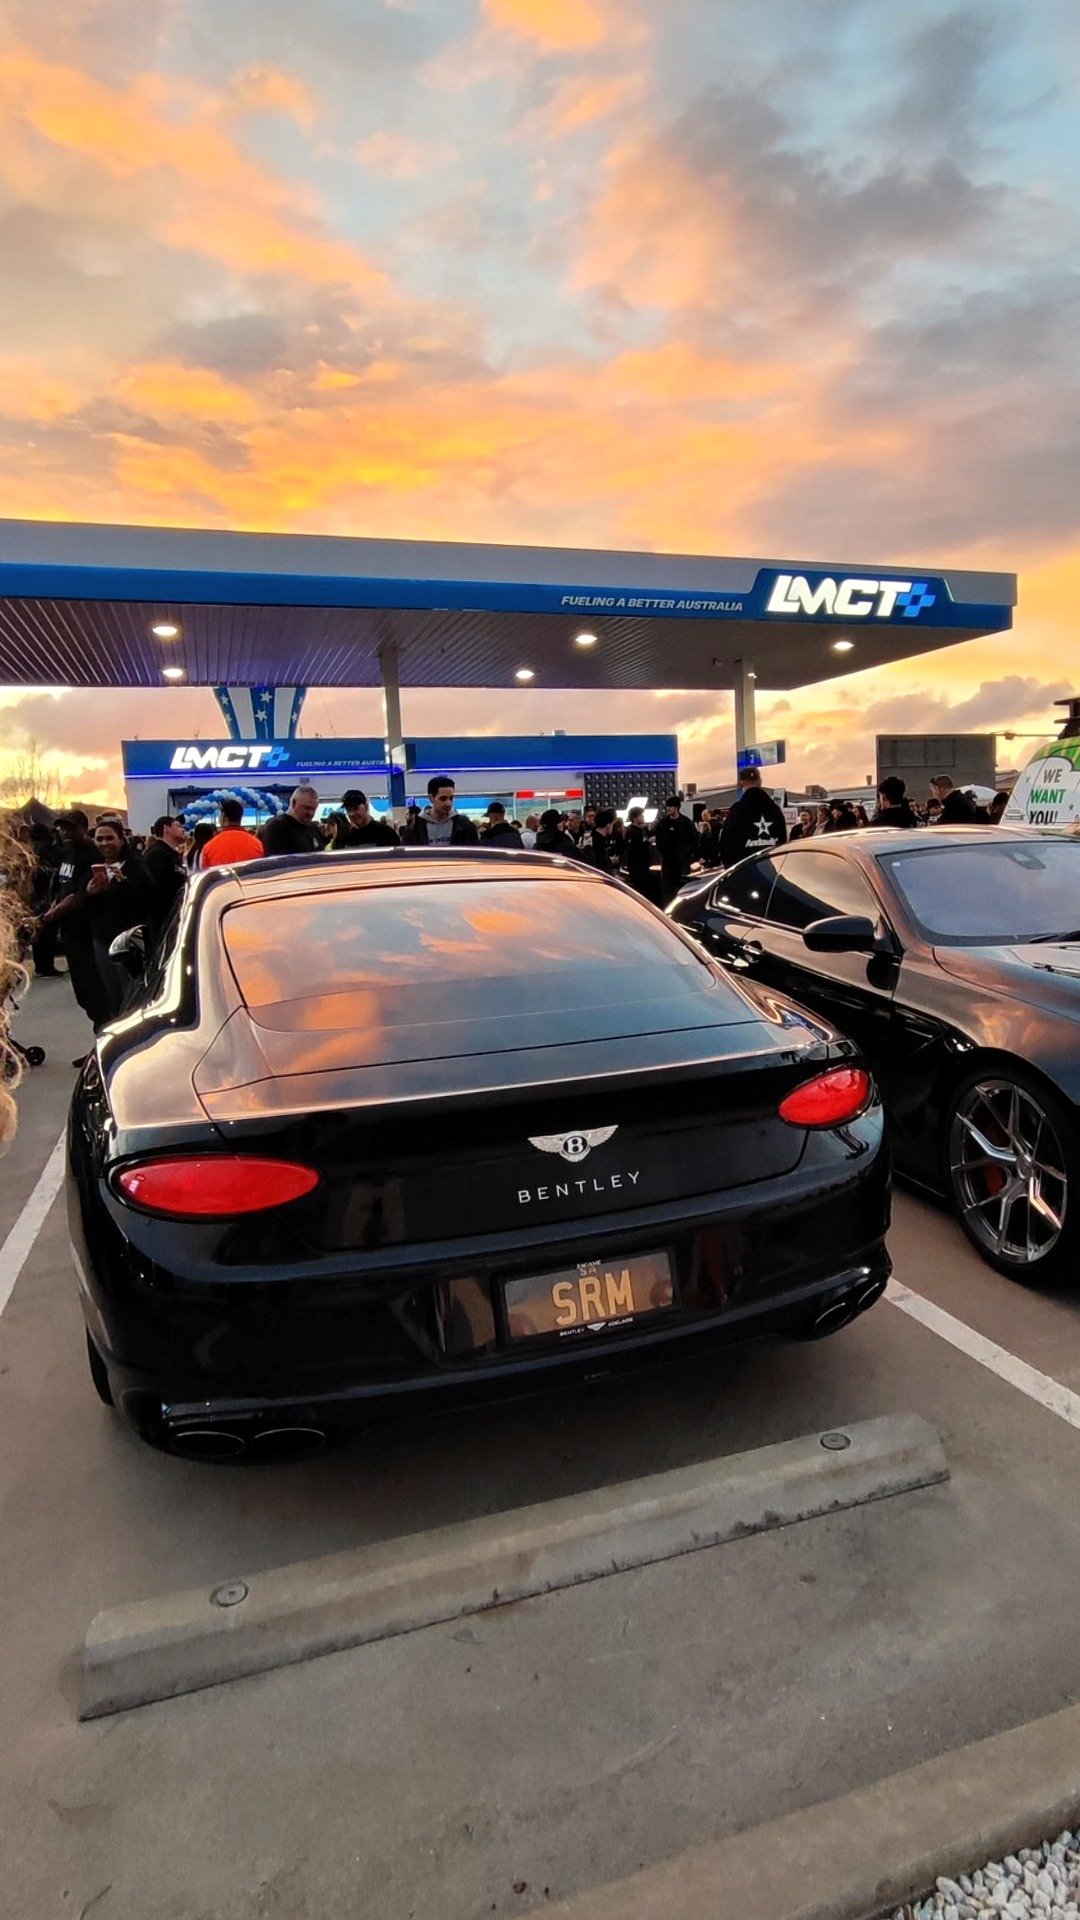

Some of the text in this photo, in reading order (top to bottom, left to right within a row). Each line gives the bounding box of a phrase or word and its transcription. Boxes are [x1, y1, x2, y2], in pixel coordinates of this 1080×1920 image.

[561, 595, 743, 612] FUELING A BETTER AUSTRALIA
[1043, 768, 1063, 784] WE
[1030, 788, 1067, 804] WANT
[1028, 810, 1059, 825] YOU!
[517, 1171, 640, 1204] BENTLEY
[552, 1269, 635, 1326] SRM
[559, 1316, 634, 1337] BENTLEY ADELAIDE
